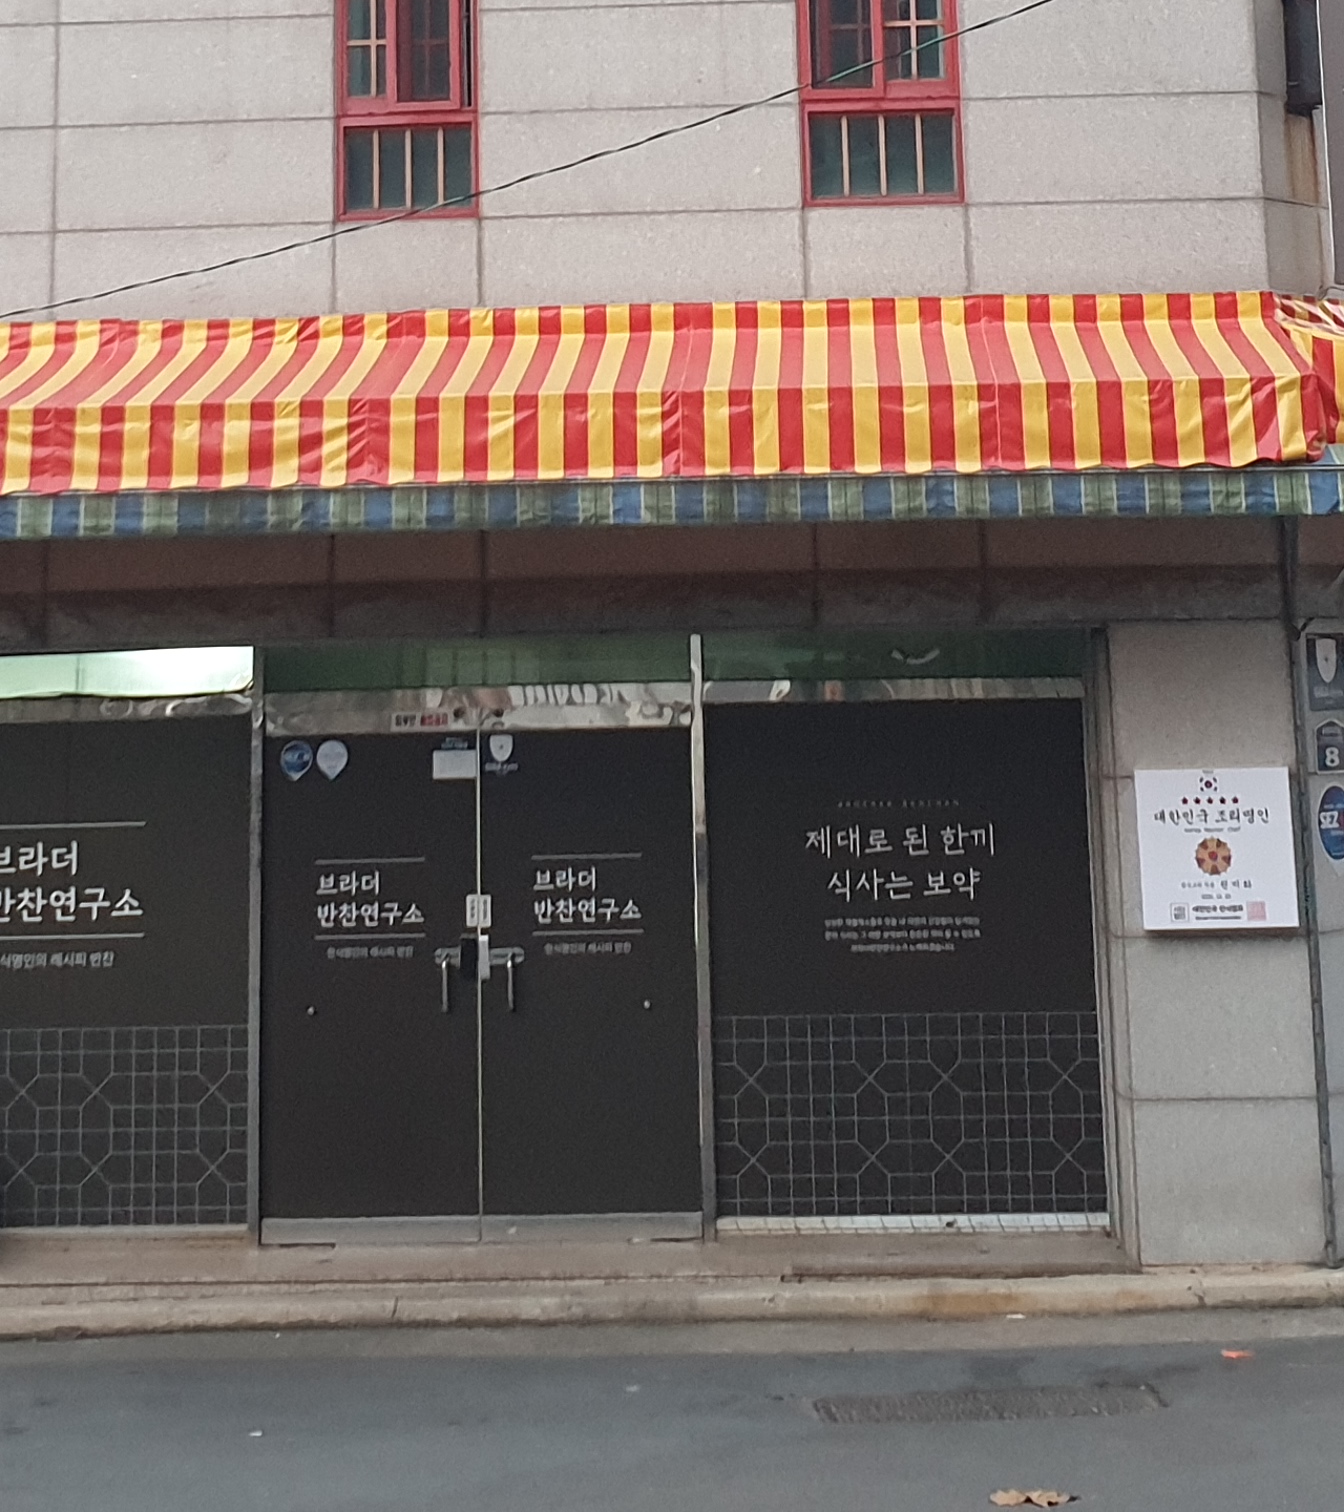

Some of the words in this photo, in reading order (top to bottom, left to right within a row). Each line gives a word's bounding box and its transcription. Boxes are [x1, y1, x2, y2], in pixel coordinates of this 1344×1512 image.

[1325, 746, 1340, 767] 8
[1154, 808, 1208, 826] 대한민국
[1215, 808, 1269, 824] 조리명인
[805, 824, 893, 859] 제대로
[903, 823, 929, 856] 된
[940, 822, 994, 856] 한끼
[316, 870, 379, 896] 브라더
[533, 865, 596, 892] 브라더
[827, 868, 913, 903] 식사는
[923, 867, 981, 901] 보약
[317, 901, 425, 928] 반찬연구소
[534, 896, 642, 924] 반찬연구소
